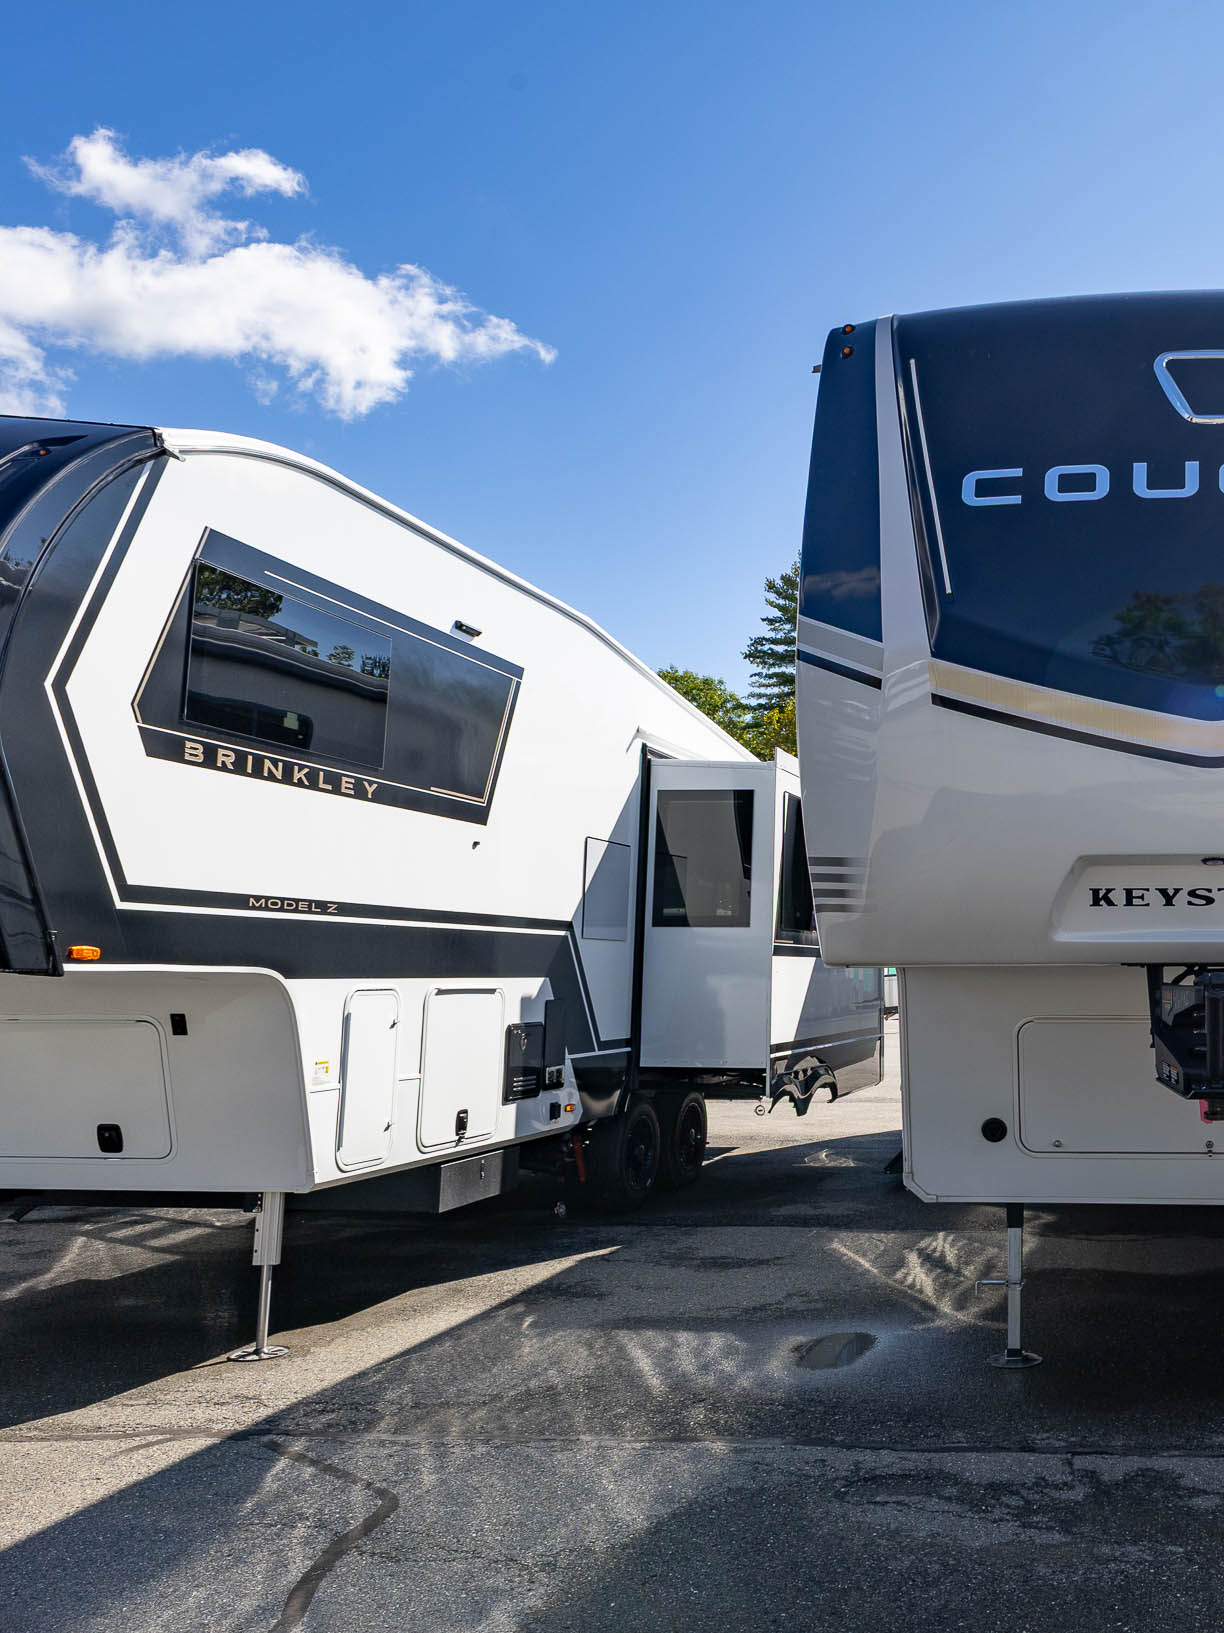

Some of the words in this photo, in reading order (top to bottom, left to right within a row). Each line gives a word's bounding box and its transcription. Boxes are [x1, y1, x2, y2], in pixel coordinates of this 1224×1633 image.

[184, 740, 378, 799] BRINKLEY
[248, 897, 321, 912] MODEL
[326, 903, 338, 913] Z
